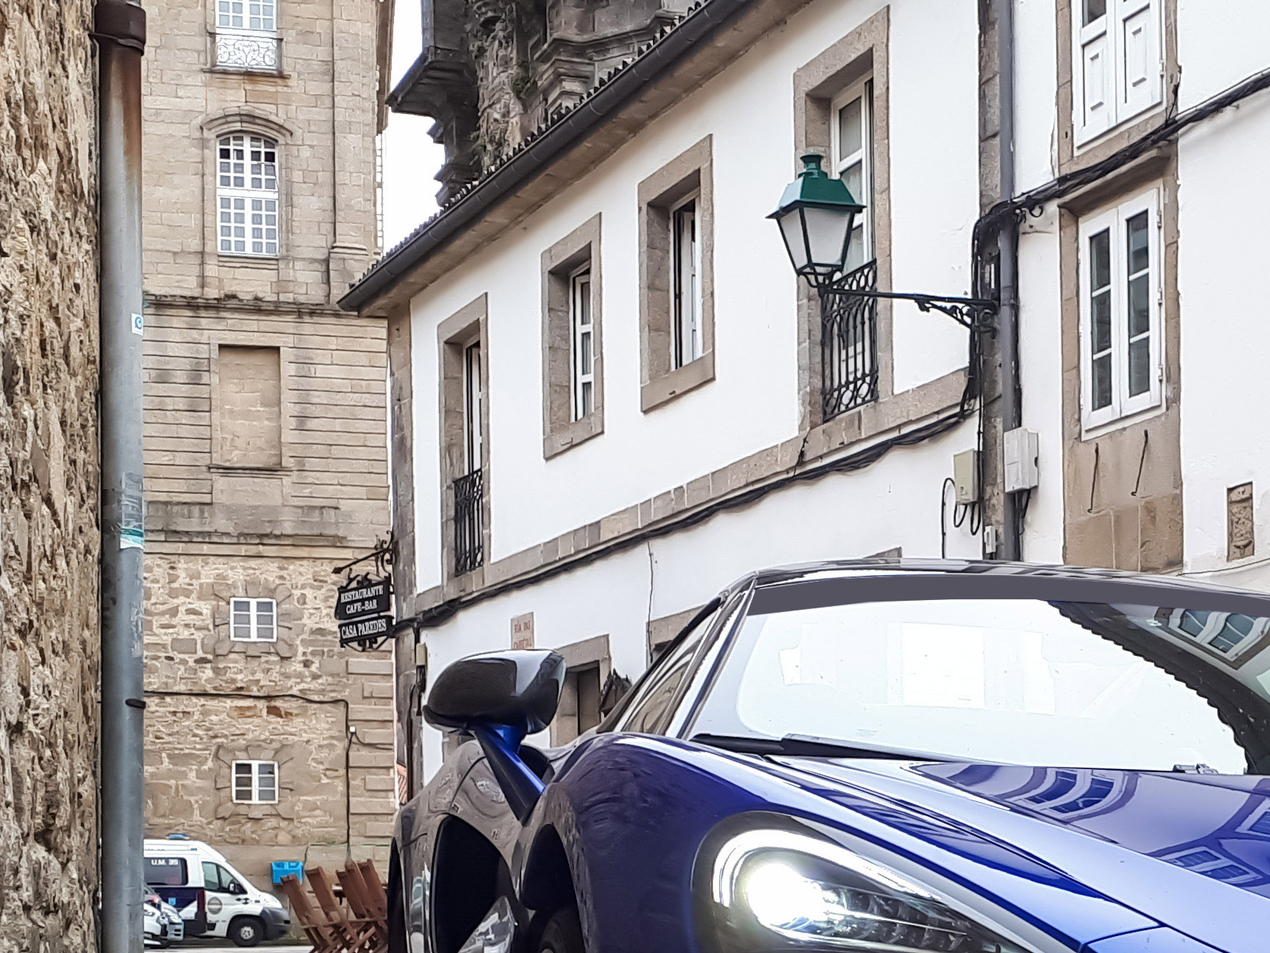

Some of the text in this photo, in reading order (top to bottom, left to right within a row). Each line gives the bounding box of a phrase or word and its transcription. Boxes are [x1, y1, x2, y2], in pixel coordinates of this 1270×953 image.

[340, 585, 384, 603] RESTAURANTE
[341, 619, 387, 639] CASA PAREDES
